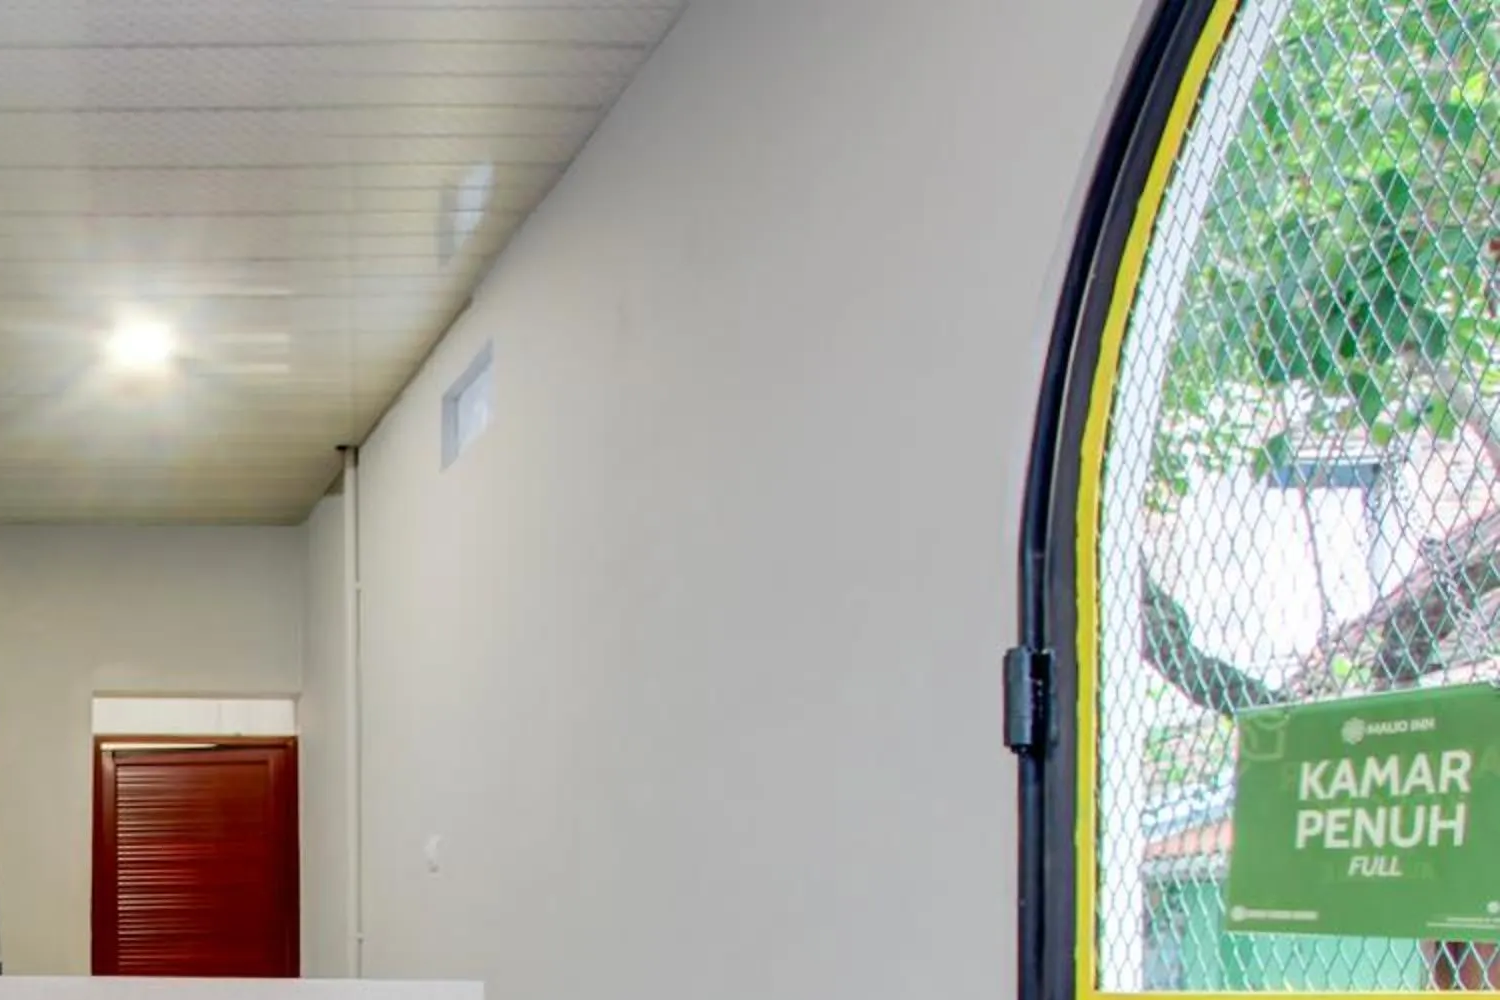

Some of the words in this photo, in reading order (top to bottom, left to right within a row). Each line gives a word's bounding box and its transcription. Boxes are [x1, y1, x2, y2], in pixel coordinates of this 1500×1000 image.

[1299, 750, 1472, 801] KAMAR
[1295, 803, 1465, 849] PENUH
[1348, 855, 1403, 877] FULL
